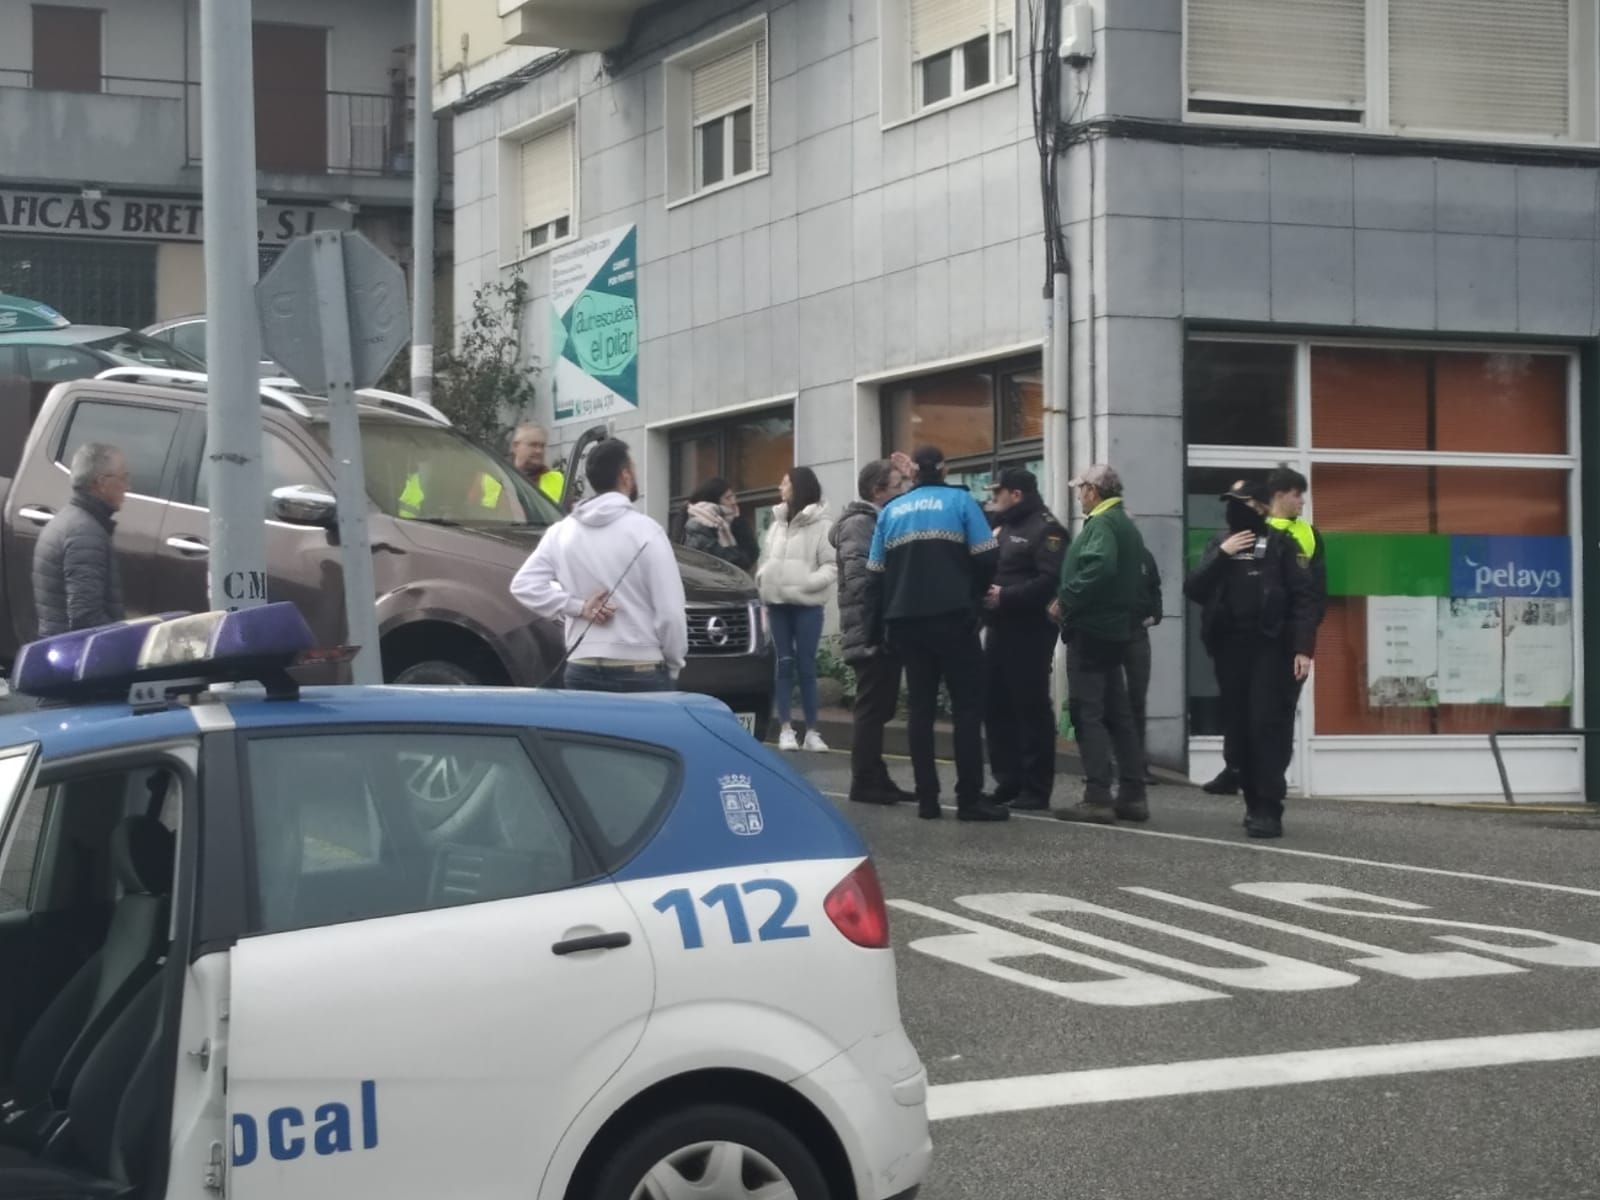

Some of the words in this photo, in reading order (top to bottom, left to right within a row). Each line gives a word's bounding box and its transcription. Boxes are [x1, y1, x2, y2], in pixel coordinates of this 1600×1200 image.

[590, 331, 604, 363] el
[605, 326, 635, 366] pilar
[223, 571, 266, 600] CM
[1474, 561, 1562, 595] pelayo
[652, 878, 811, 950] 112
[886, 881, 1600, 1006] STOP
